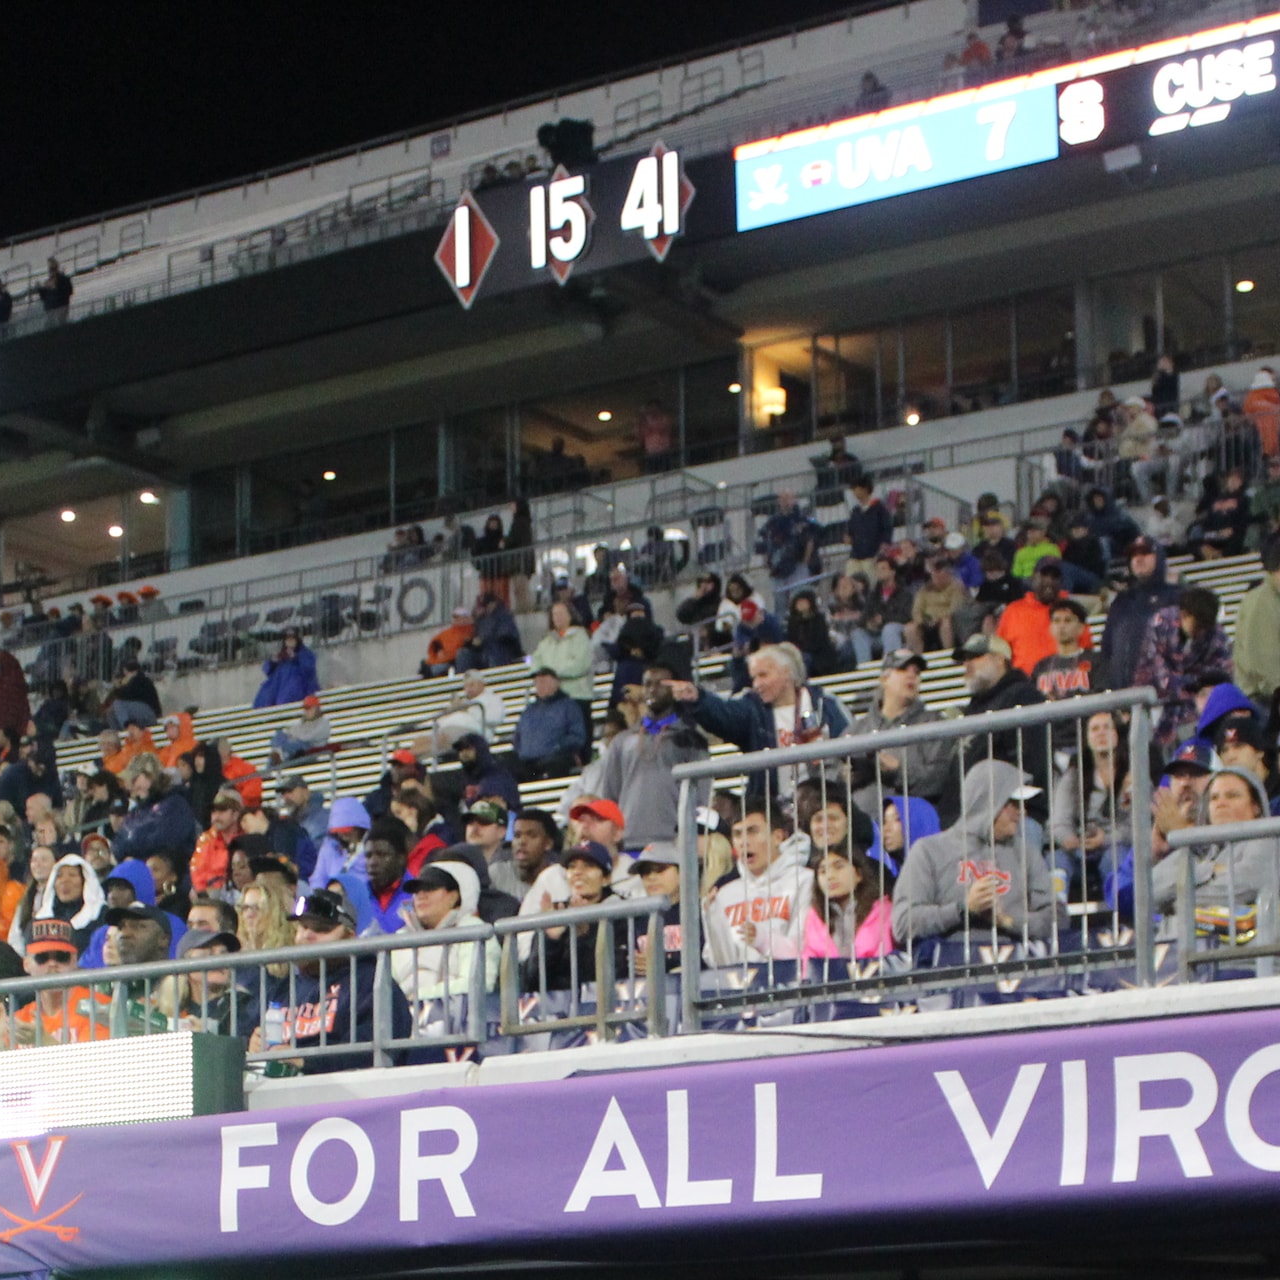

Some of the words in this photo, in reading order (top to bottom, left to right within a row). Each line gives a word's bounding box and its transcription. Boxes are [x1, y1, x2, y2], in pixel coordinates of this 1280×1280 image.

[1152, 39, 1277, 115] CUSE
[836, 125, 933, 189] UVA
[975, 100, 1017, 162] 7
[530, 175, 587, 270] 15
[620, 151, 680, 240] 41
[219, 1106, 479, 1233] FOR
[563, 1082, 824, 1213] ALL
